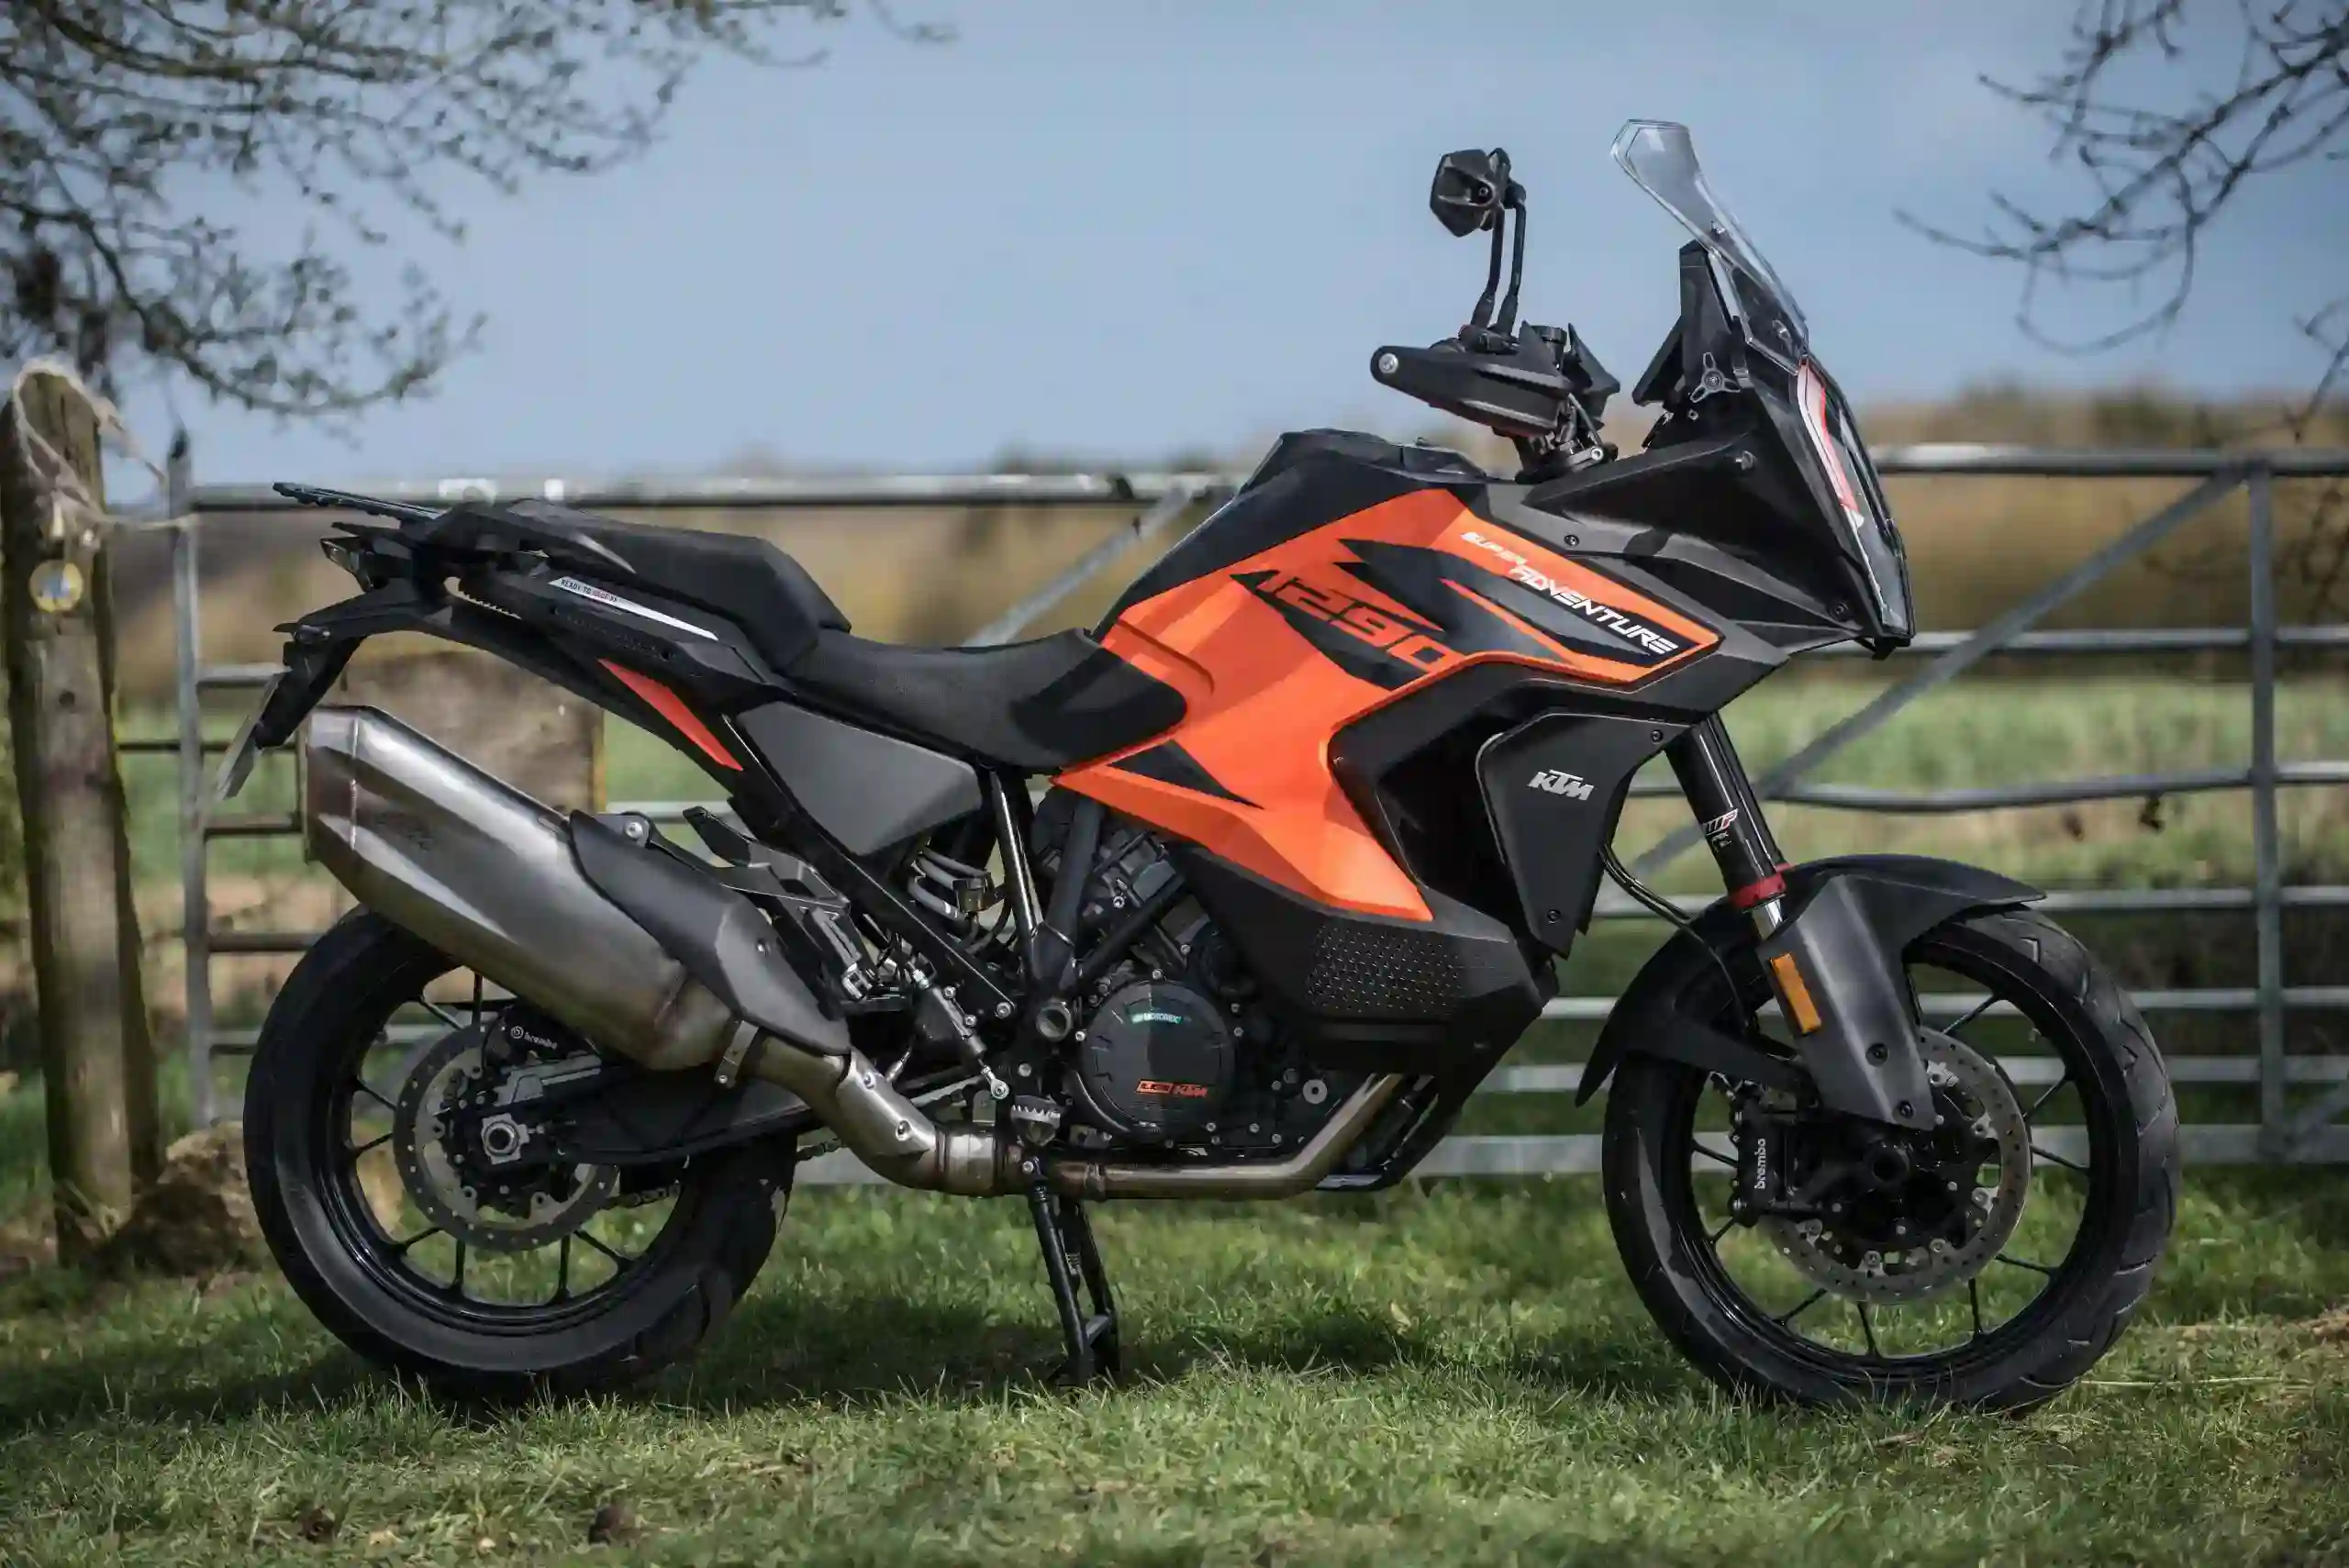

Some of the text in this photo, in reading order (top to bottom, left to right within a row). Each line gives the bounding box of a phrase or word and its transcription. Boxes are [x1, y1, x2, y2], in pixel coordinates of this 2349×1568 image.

[1508, 564, 1679, 655] ADVENTURE
[1527, 769, 1595, 801] KTM
[1753, 1138, 1766, 1190] brembo
